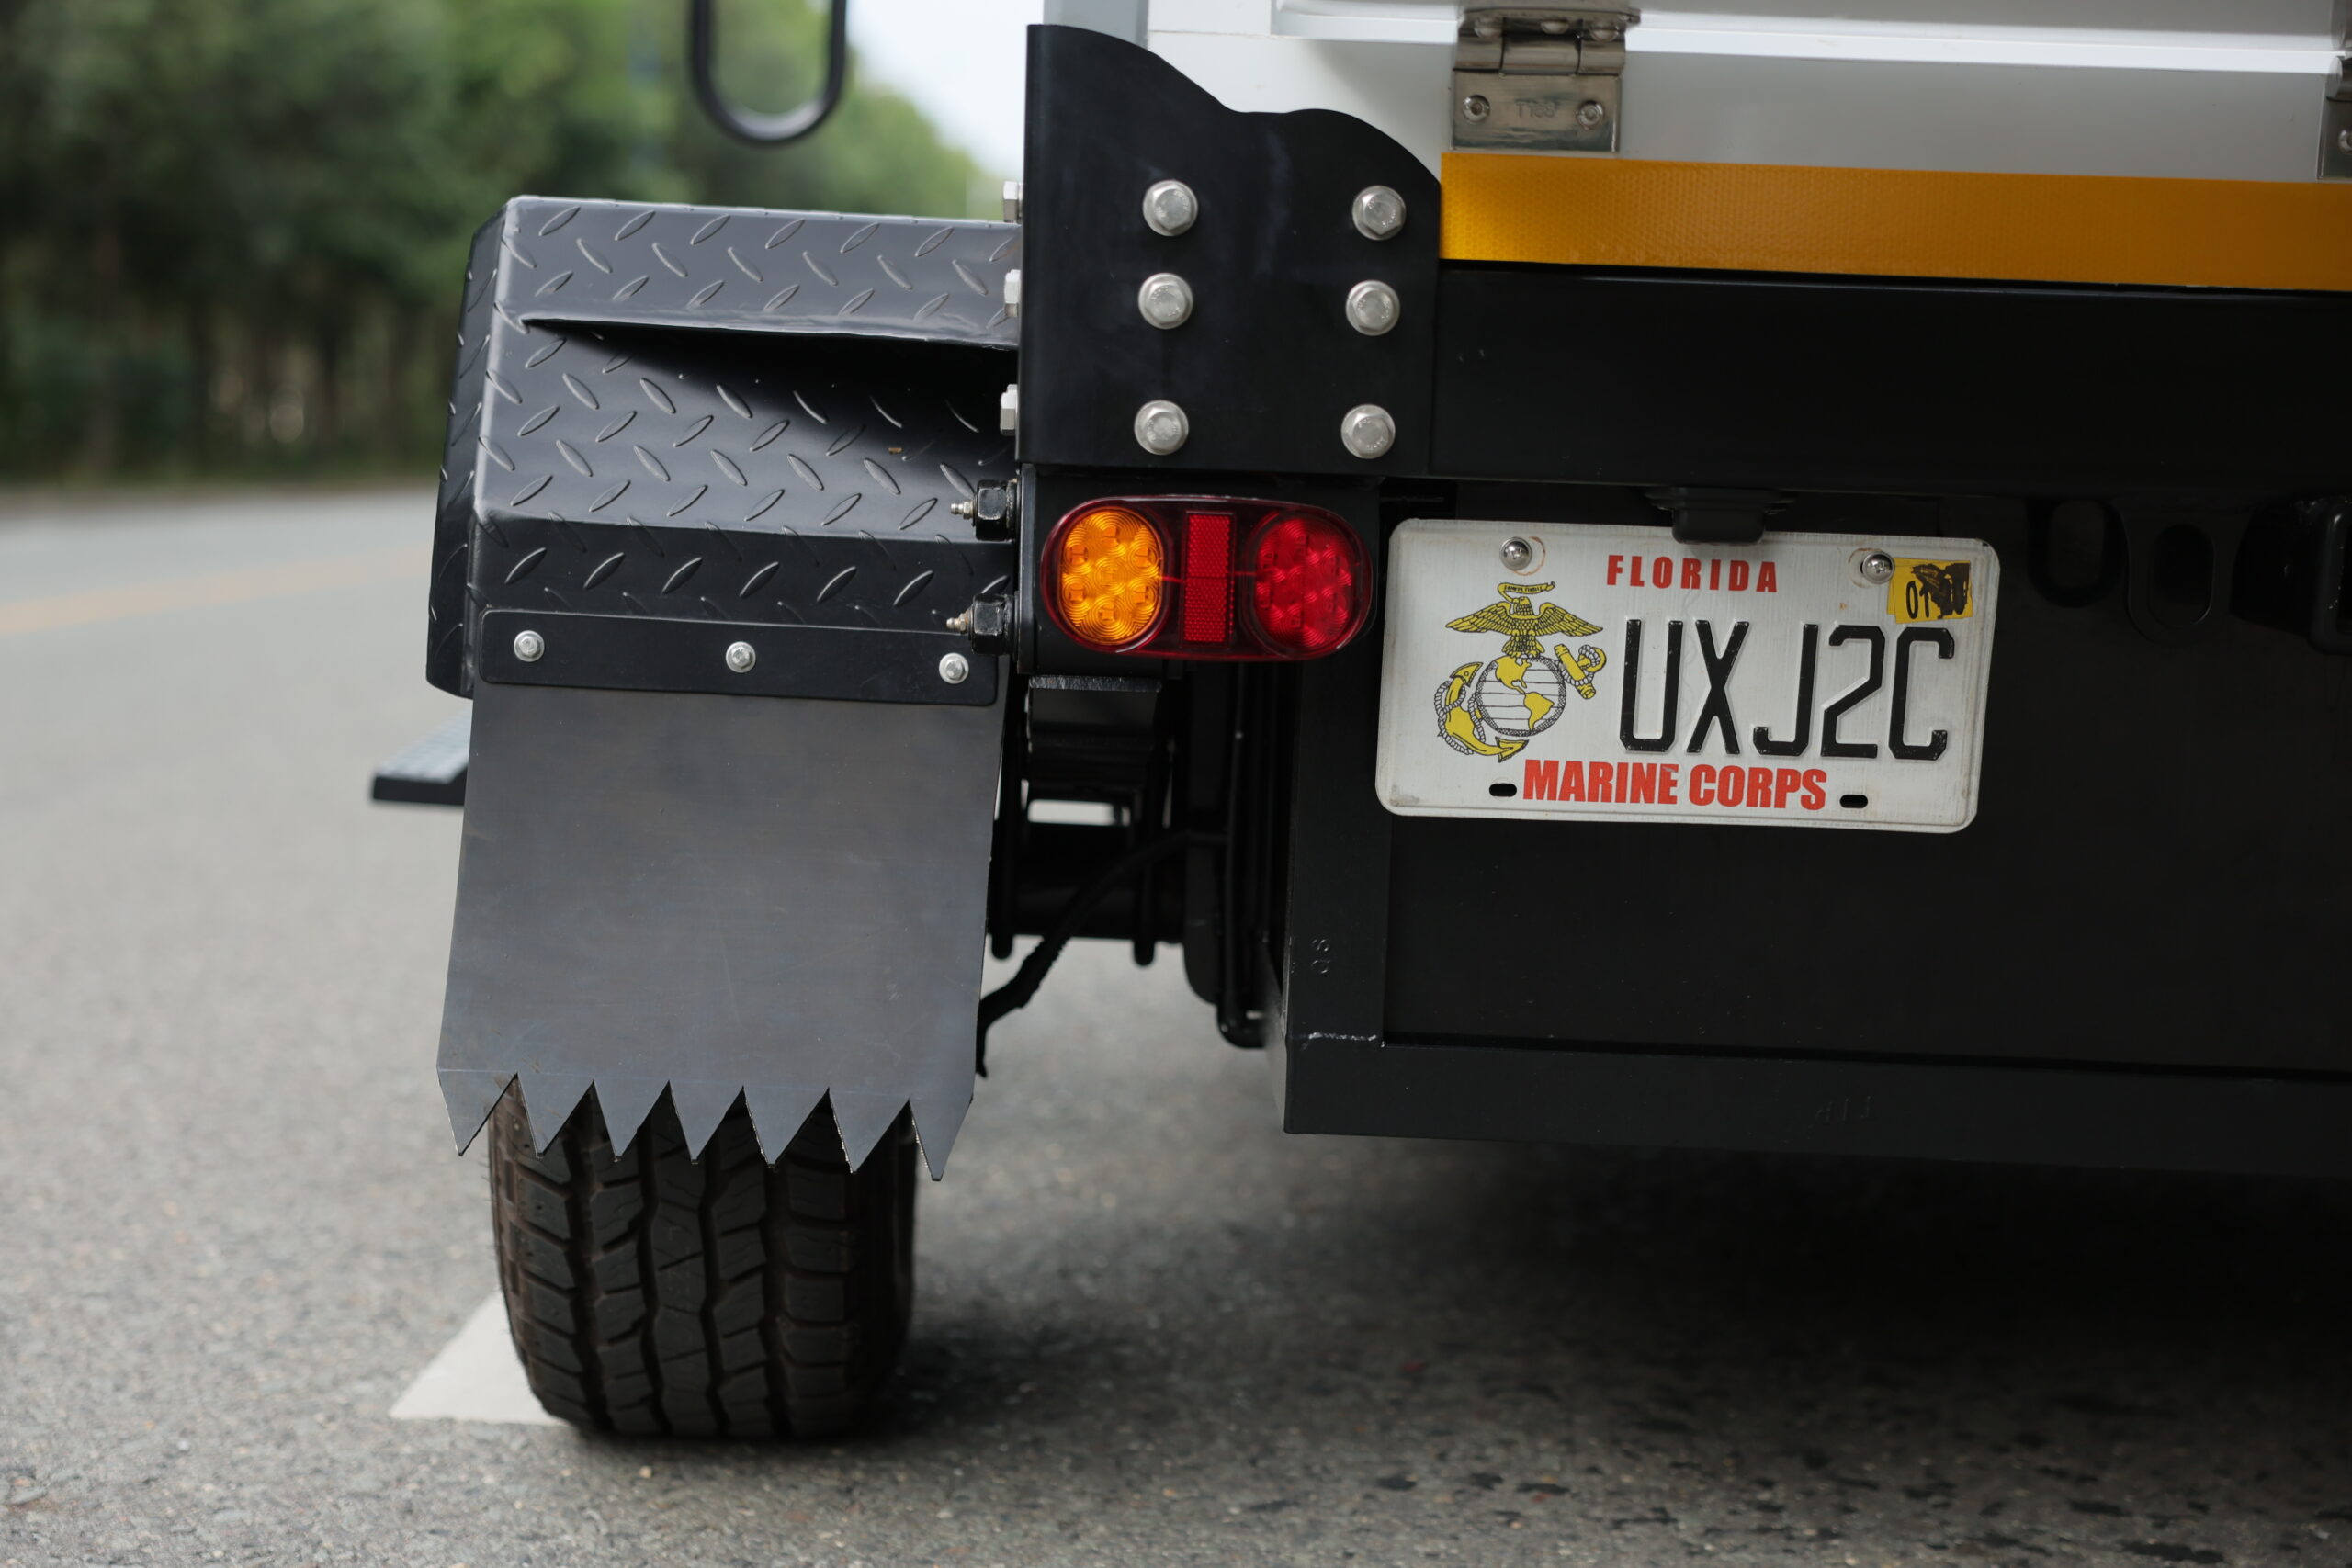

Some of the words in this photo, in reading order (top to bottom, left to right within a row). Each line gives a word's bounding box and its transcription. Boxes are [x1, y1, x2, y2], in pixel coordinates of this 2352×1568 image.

[1607, 555, 1778, 592] FLORIDA
[1619, 618, 1955, 761] UXJ2C
[1522, 759, 1679, 805] MARINE
[1689, 764, 1827, 811] CORPS
